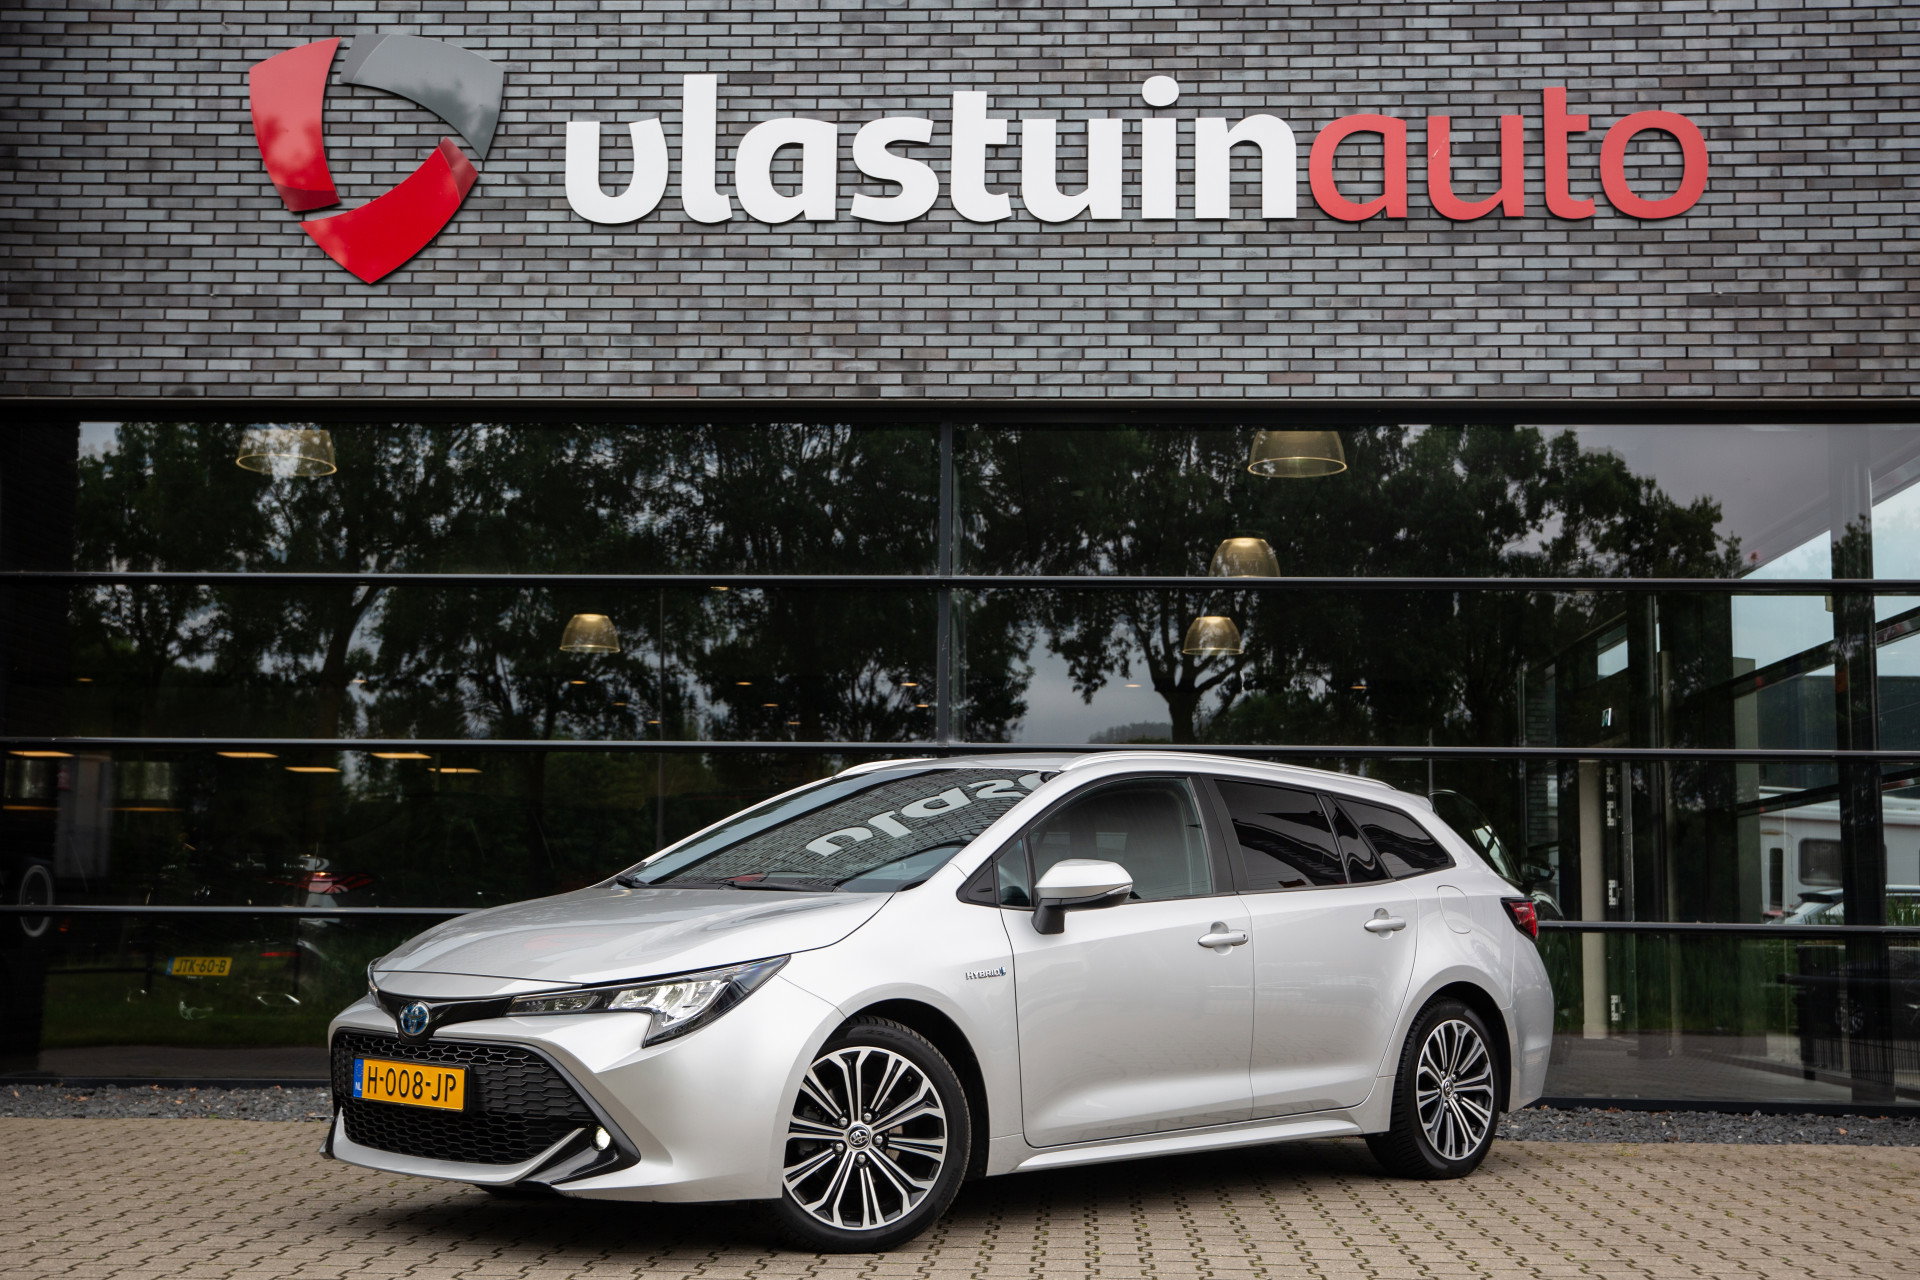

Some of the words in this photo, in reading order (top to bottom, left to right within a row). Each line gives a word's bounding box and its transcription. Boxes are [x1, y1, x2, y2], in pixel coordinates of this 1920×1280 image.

[965, 967, 1000, 980] HYBRID
[355, 1081, 362, 1091] NL
[367, 1066, 456, 1102] H-008-JP
